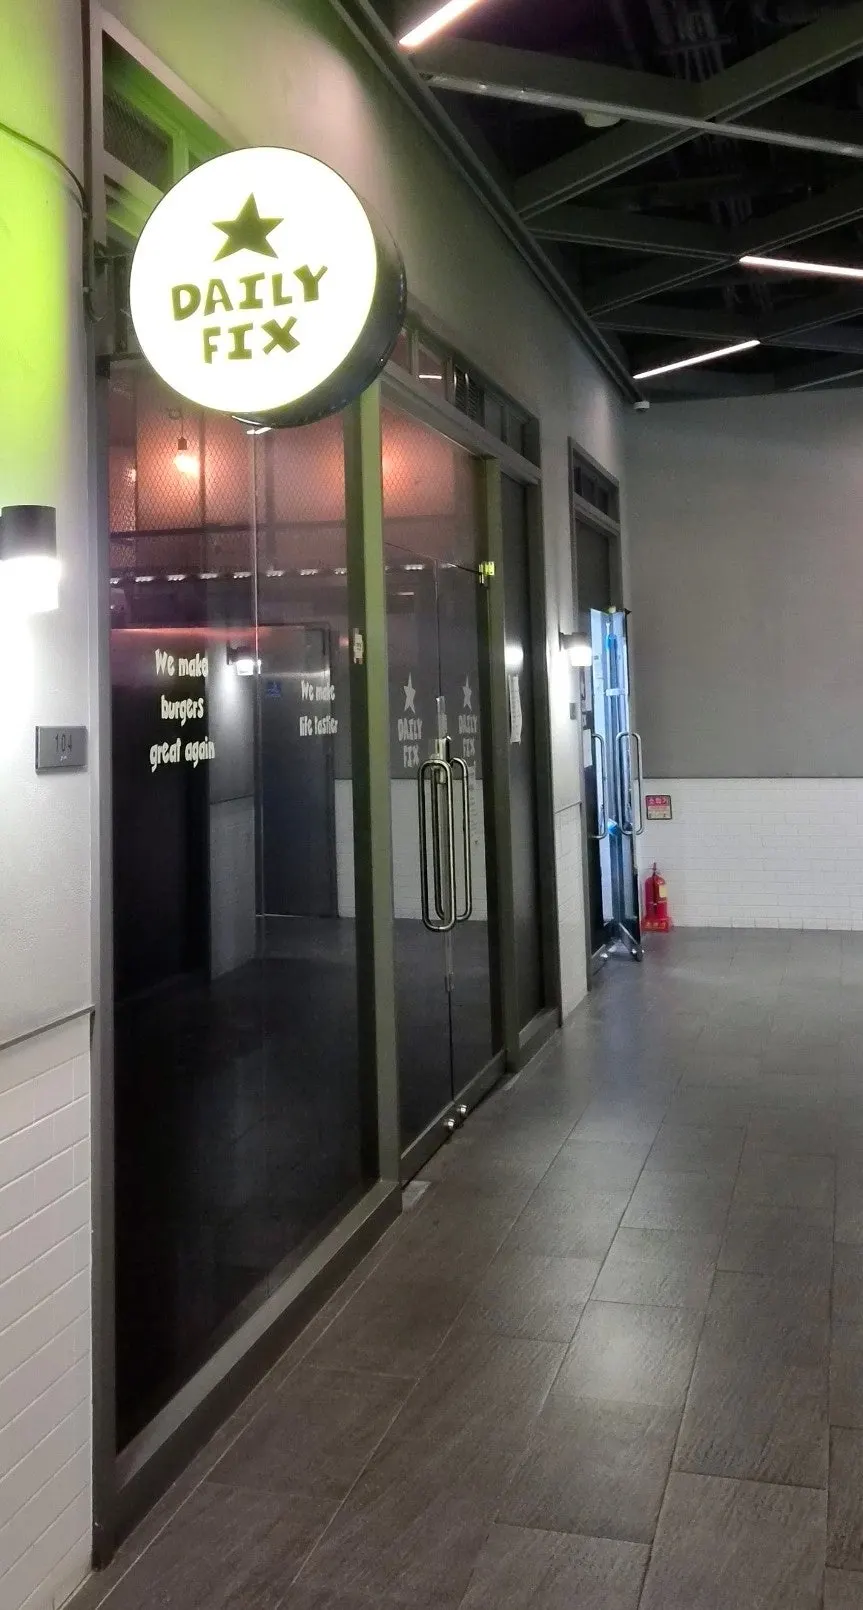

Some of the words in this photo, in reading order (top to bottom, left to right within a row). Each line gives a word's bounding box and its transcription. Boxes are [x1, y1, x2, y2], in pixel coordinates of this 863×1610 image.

[171, 264, 328, 321] DAILY
[202, 316, 300, 364] FIX
[155, 648, 175, 677] We
[178, 653, 208, 677] make
[301, 680, 314, 701] We
[315, 682, 335, 701] make
[161, 694, 204, 726] burgers
[299, 716, 312, 737] life
[398, 718, 422, 741] DAILY
[54, 733, 73, 752] 104
[149, 738, 181, 773] great
[185, 736, 215, 769] again
[404, 745, 419, 768] FIX
